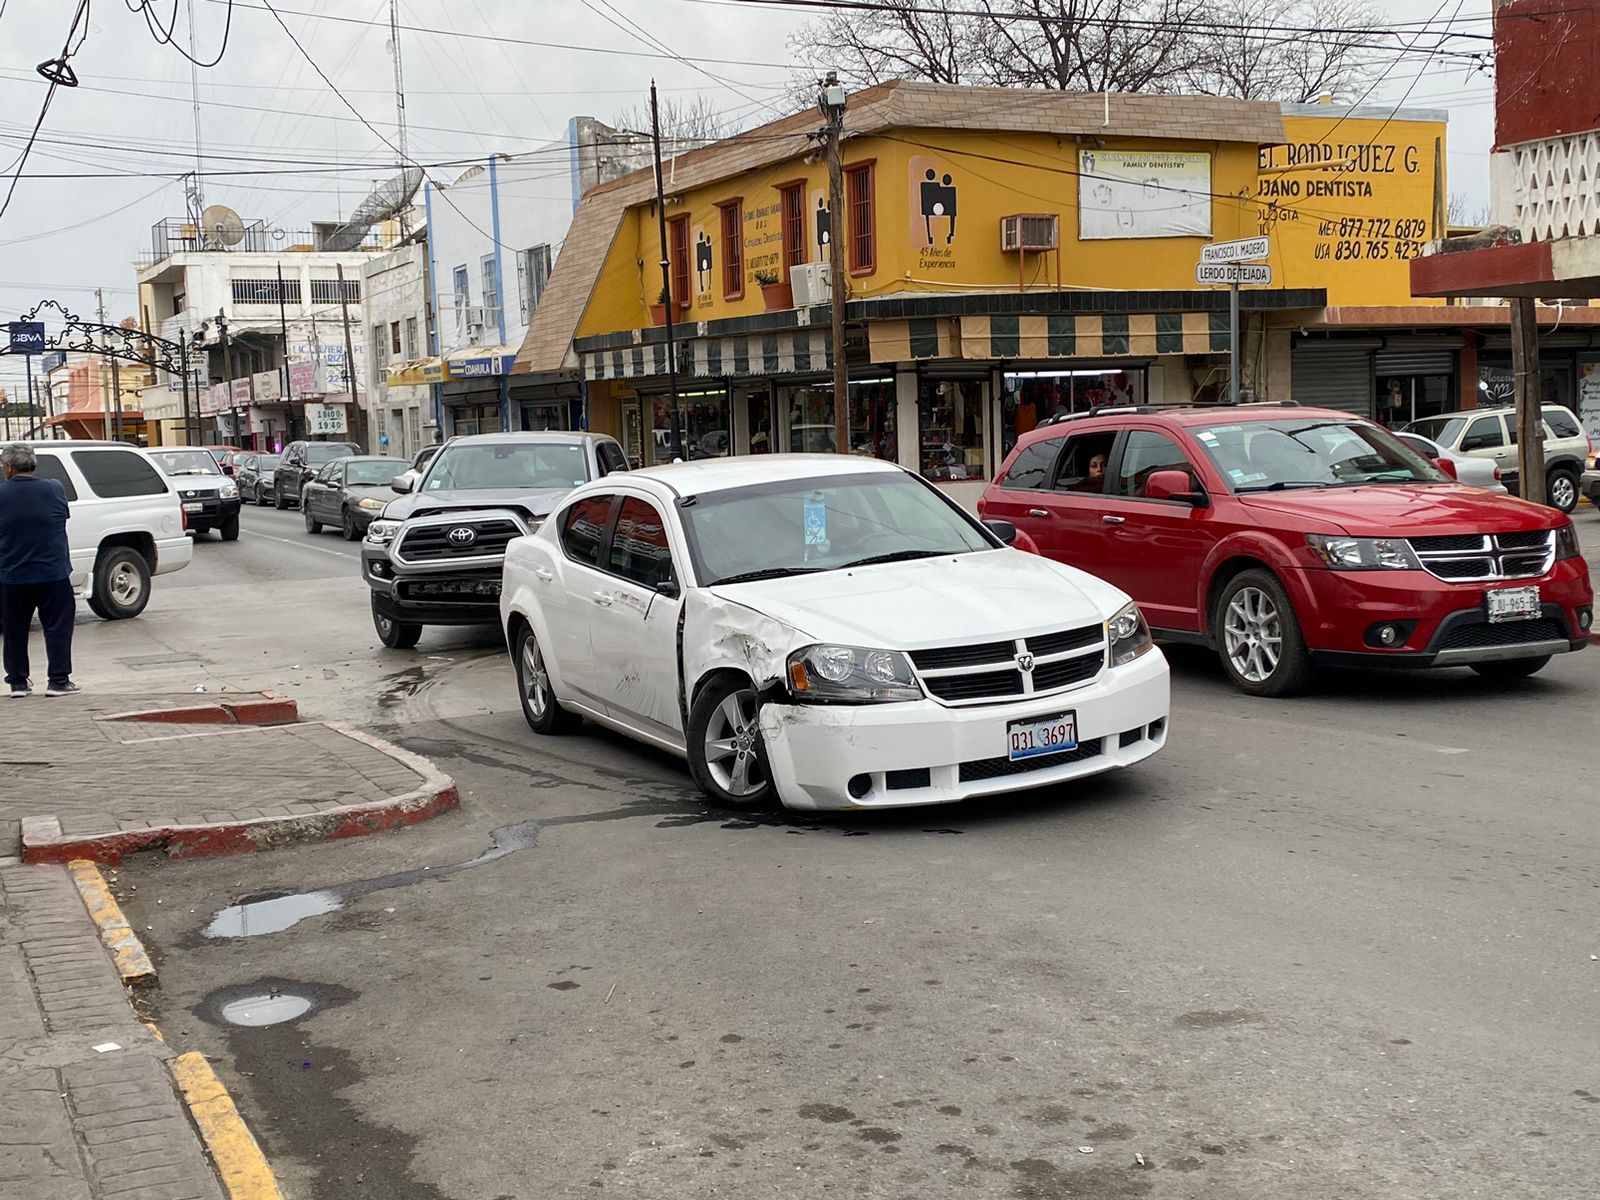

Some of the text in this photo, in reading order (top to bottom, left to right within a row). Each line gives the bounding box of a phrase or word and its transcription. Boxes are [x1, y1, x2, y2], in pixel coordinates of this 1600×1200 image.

[1287, 143, 1396, 173] RODRIGUEZ
[1404, 145, 1420, 173] G.
[1306, 180, 1373, 198] DENTISTA
[1340, 217, 1426, 239] 877.772.6879
[1204, 245, 1235, 260] FRANCISCO
[1240, 241, 1266, 256] MADERO
[1200, 267, 1268, 281] LERDO DE TEJADA
[12, 333, 43, 343] BBVA
[465, 363, 491, 376] COAHUILA
[1042, 722, 1073, 747] 3697
